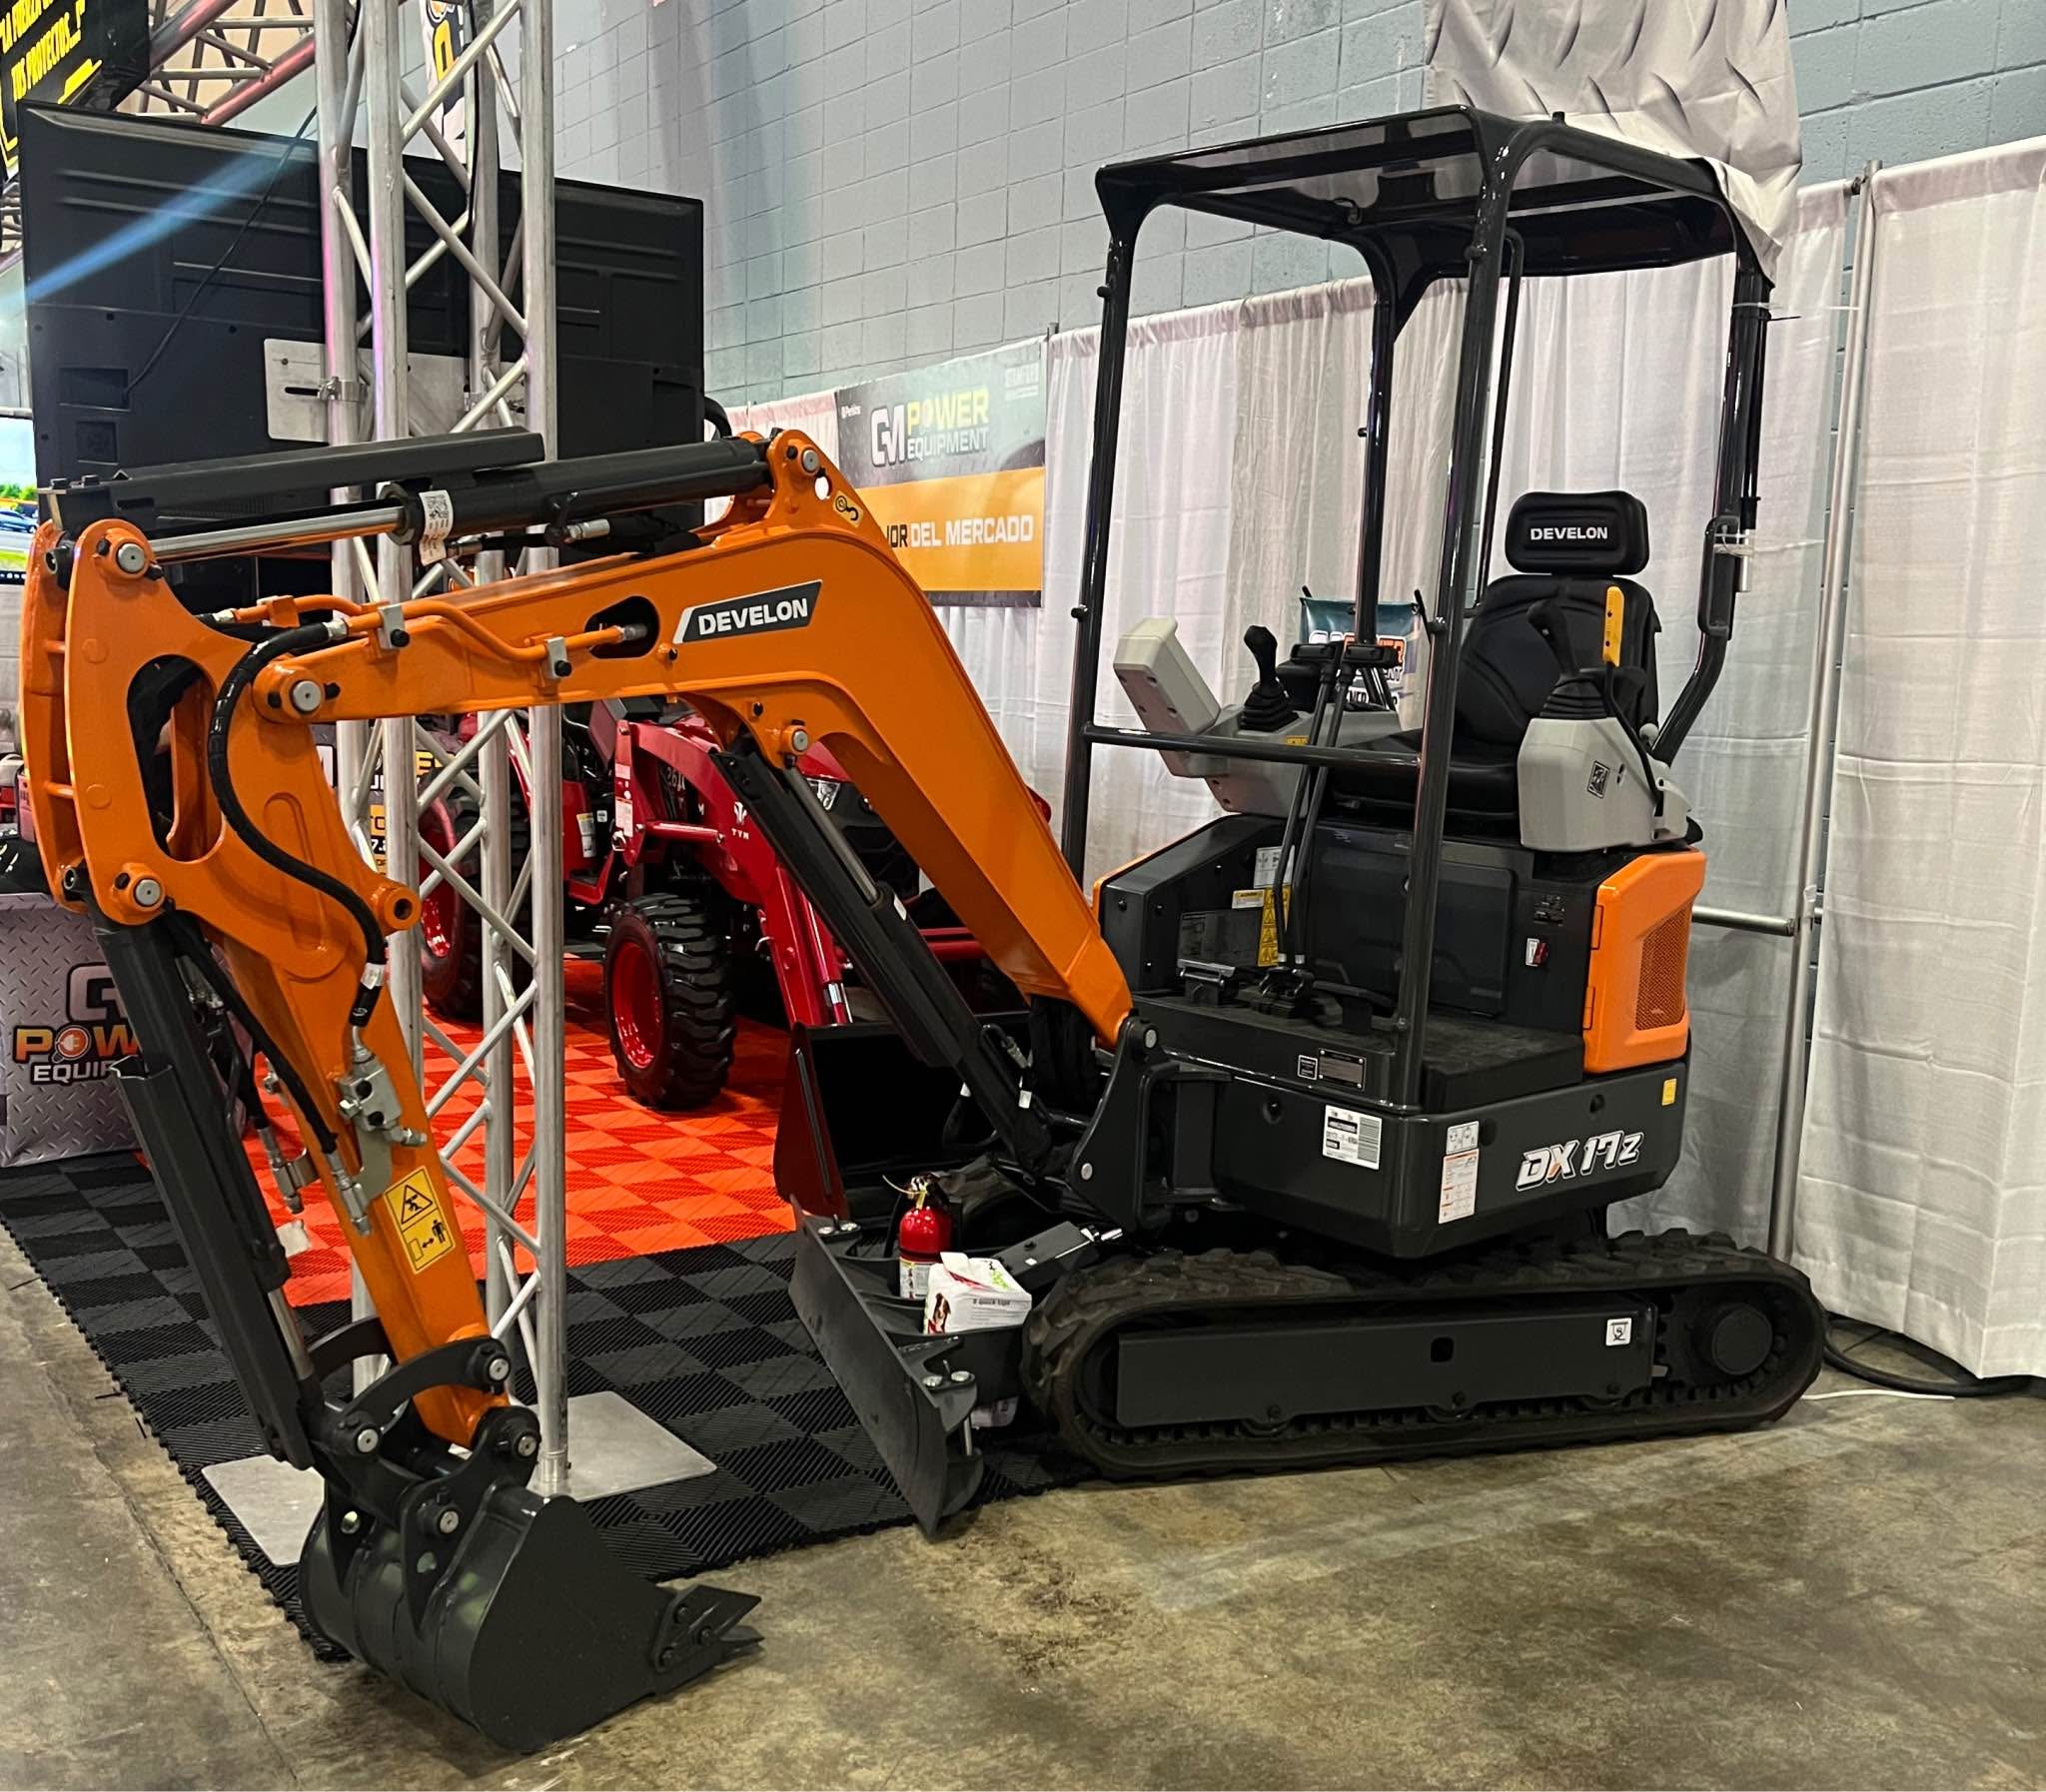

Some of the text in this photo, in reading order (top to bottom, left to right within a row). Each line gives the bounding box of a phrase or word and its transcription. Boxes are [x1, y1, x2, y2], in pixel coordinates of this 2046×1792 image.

[871, 387, 990, 467] GM POWER
[907, 429, 990, 461] EQUIPMENT
[910, 520, 942, 547] DEL
[945, 514, 1034, 546] MERCADO
[1530, 527, 1608, 540] DEVELON
[698, 598, 808, 635] DEVELON
